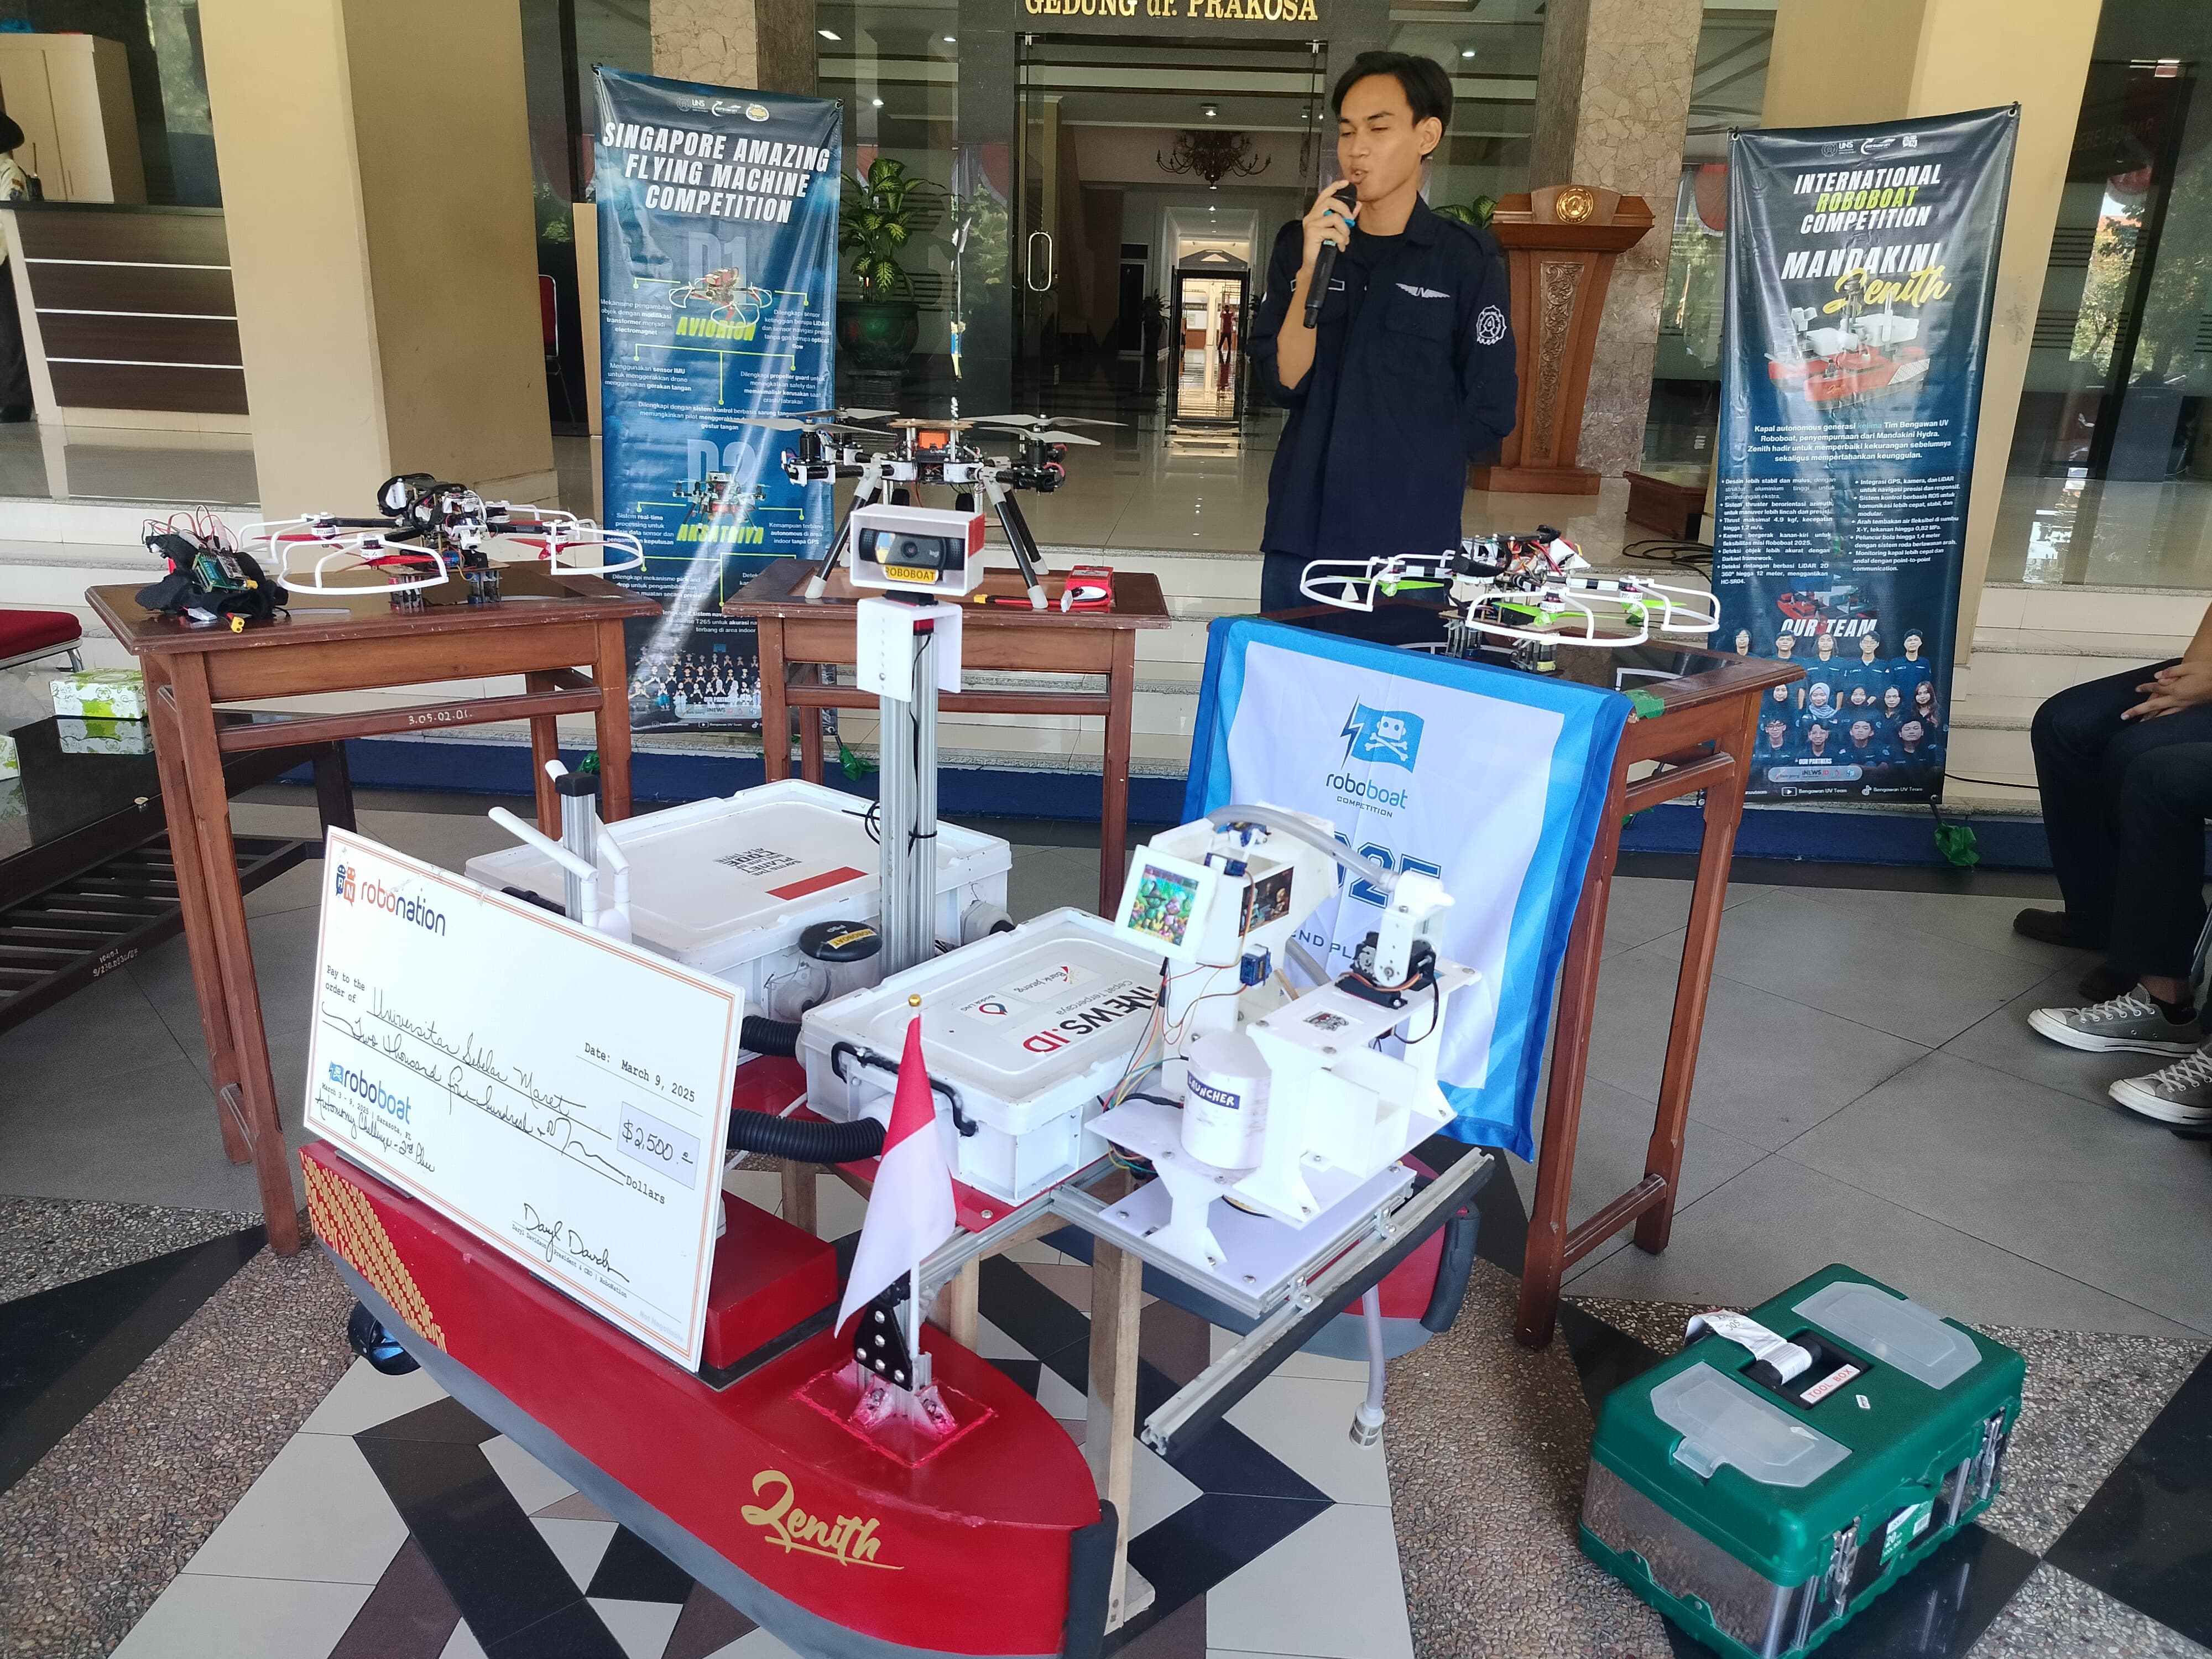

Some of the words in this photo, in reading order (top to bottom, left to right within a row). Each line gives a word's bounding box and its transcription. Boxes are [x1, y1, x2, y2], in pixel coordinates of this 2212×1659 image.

[1026, 0, 1136, 15] GEDUNG
[1188, 0, 1318, 21] PRAKOSA
[603, 122, 727, 159] SINGAPORE
[733, 138, 830, 172] AMAZING
[625, 154, 703, 191] FLYING
[711, 164, 810, 197] MACHINE
[1793, 164, 1940, 194] INTERNATIONAL
[645, 185, 792, 223] COMPETITION
[1815, 186, 1919, 212] ROBOBOAT
[1801, 206, 1931, 234] COMPETITION
[689, 231, 747, 304] D1
[1781, 243, 1940, 279] MANDAKINI
[1822, 263, 1951, 314] Zenith
[1799, 434, 1859, 442] penyempurnaan
[1877, 452, 1922, 460] keunggulan.
[1780, 619, 1819, 637] OUR
[1826, 619, 1877, 637] TEAM
[1326, 773, 1408, 810] roboboat
[1337, 796, 1392, 818] COMPETITION
[361, 879, 445, 936] robonation
[326, 983, 345, 997] order
[348, 994, 357, 1003] of
[327, 965, 338, 979] Pay
[343, 973, 349, 983] to
[354, 978, 365, 991] the
[585, 1042, 610, 1062] Date:
[622, 1060, 649, 1081] March
[655, 1075, 664, 1091] 9,
[672, 1083, 695, 1102] 2025
[344, 1070, 411, 1125] roboboat
[1189, 1076, 1235, 1107] LAUNCHER
[322, 1083, 336, 1095] March
[349, 1099, 354, 1107] 9,
[357, 1103, 369, 1114] 2025
[377, 1115, 402, 1136] Sarasota,
[626, 1176, 665, 1204] Dollars
[1807, 1383, 1833, 1397] TOOL
[1833, 1369, 1851, 1381] BOX
[741, 1470, 881, 1567] Zenith
